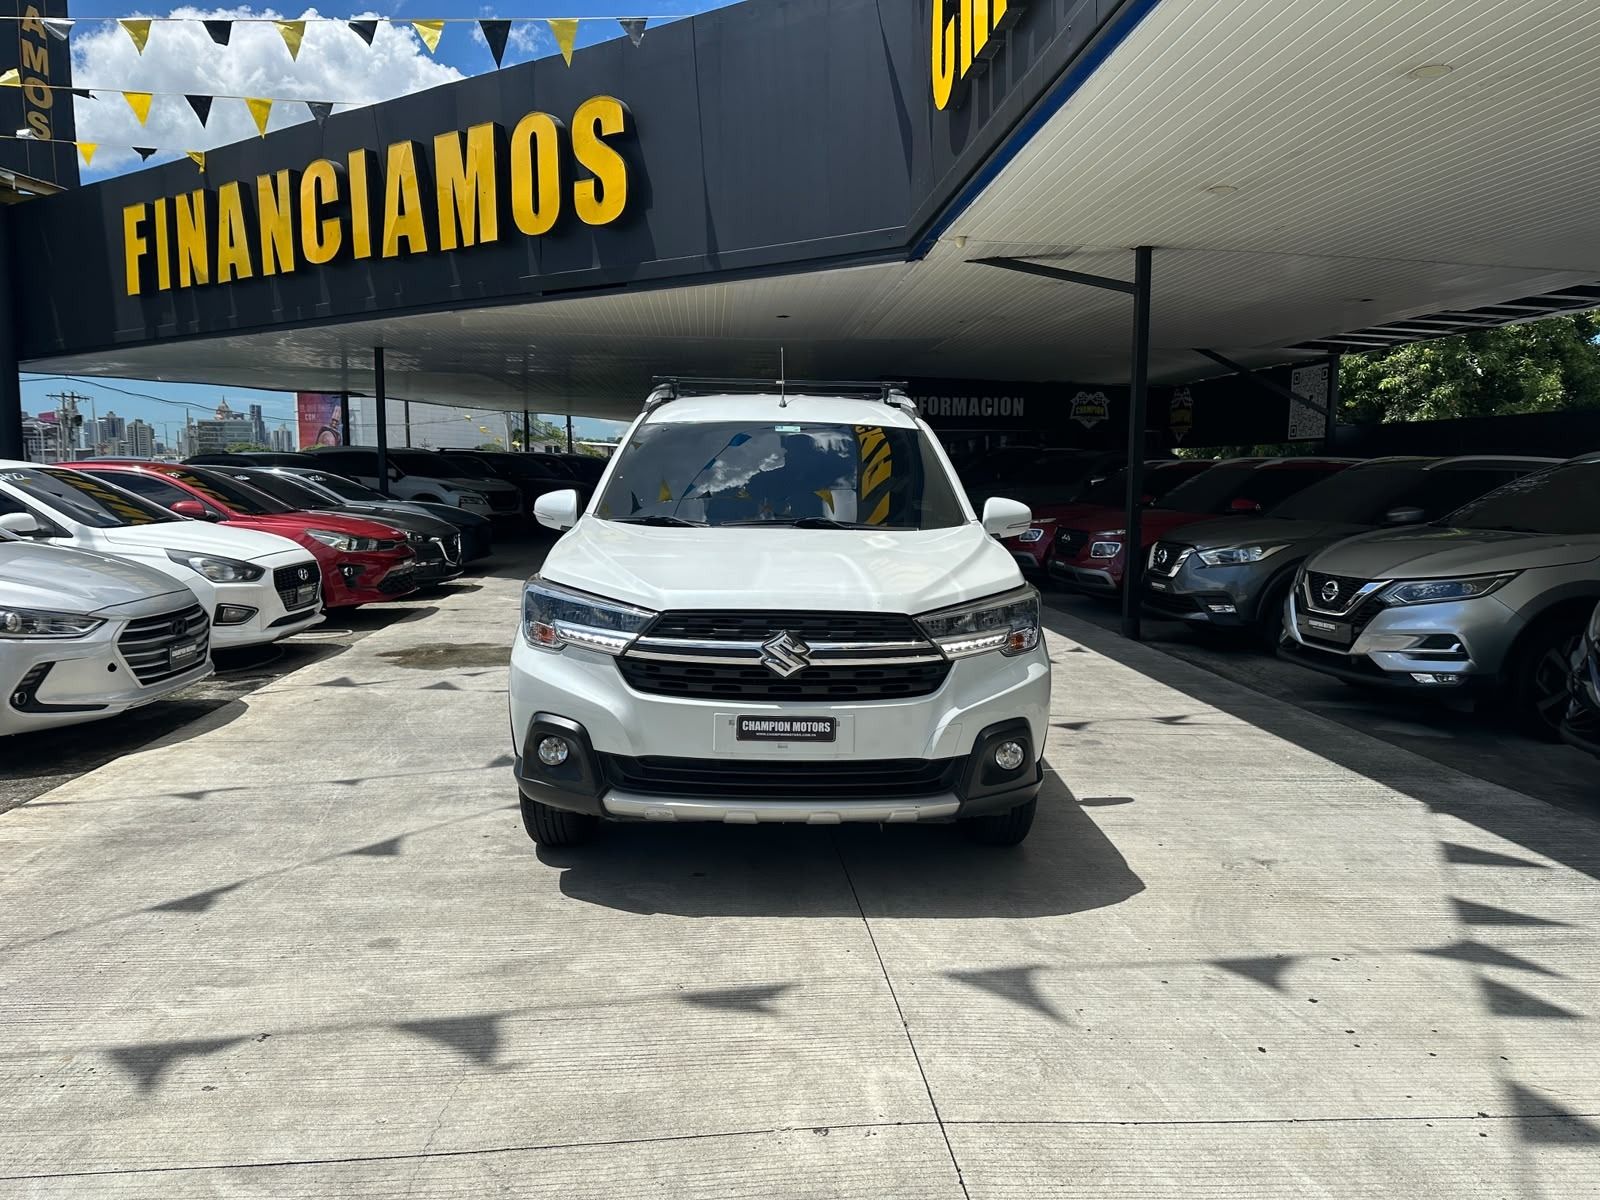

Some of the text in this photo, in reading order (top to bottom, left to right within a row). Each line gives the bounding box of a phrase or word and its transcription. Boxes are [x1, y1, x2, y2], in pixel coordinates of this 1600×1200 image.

[122, 96, 627, 296] FINANCIAMOS
[912, 395, 1025, 417] FORMACION
[742, 720, 831, 733] CHAMPION MOTORS
